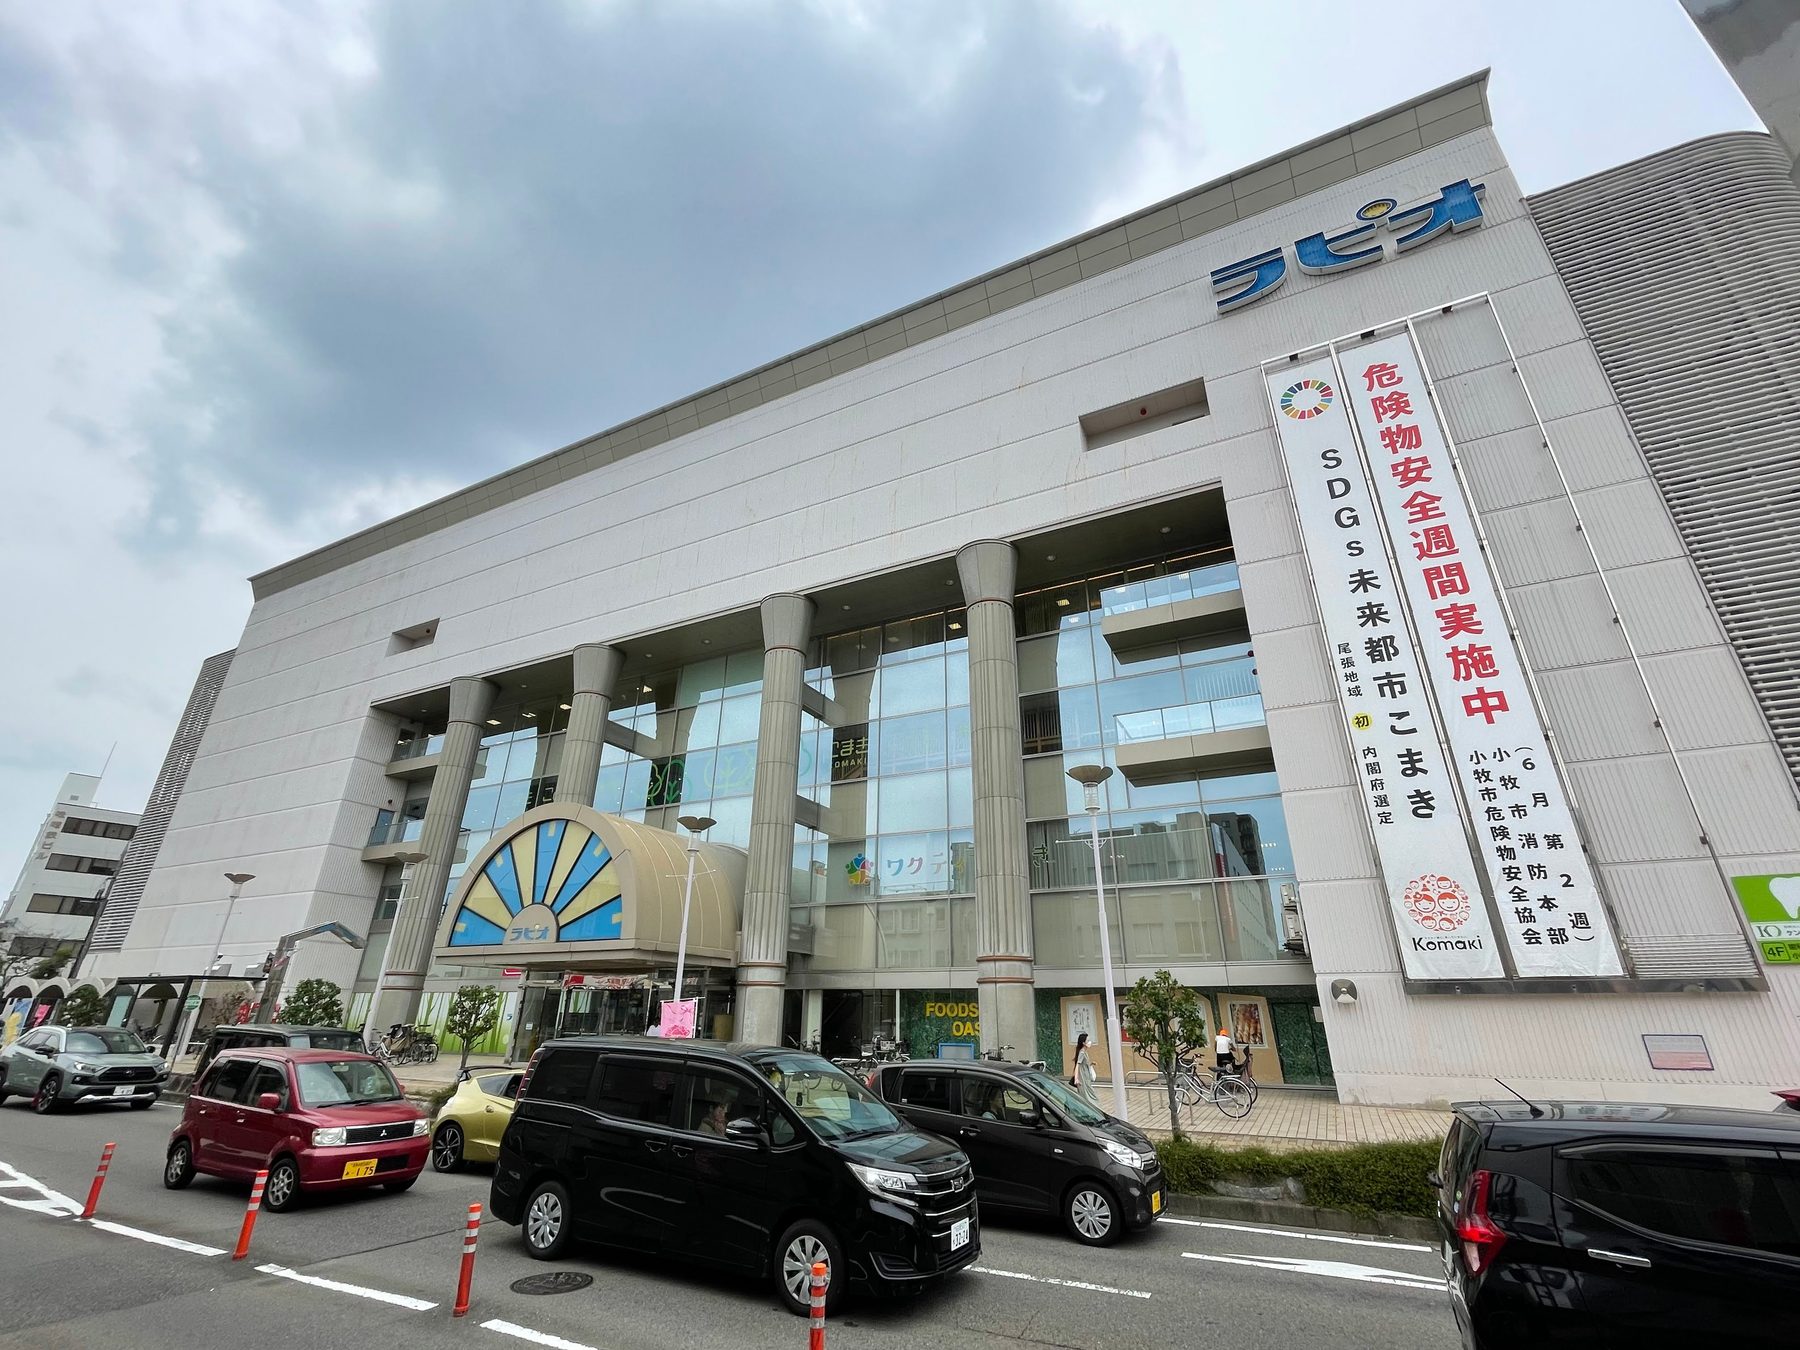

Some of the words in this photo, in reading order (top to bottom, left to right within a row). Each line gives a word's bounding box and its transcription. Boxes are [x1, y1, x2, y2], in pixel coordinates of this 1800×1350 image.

[1210, 178, 1486, 314] ラピオ
[1362, 361, 1511, 726] 危険物安全週間実施中
[834, 757, 867, 769] OMAKI
[1469, 750, 1543, 946] 小牧市危険物安全協会
[1492, 747, 1570, 946] 小牧市消防本部
[509, 924, 549, 941] ラピオ
[1412, 935, 1483, 951] Komaki
[1767, 946, 1785, 957] 4F
[925, 1002, 979, 1018] FOODS
